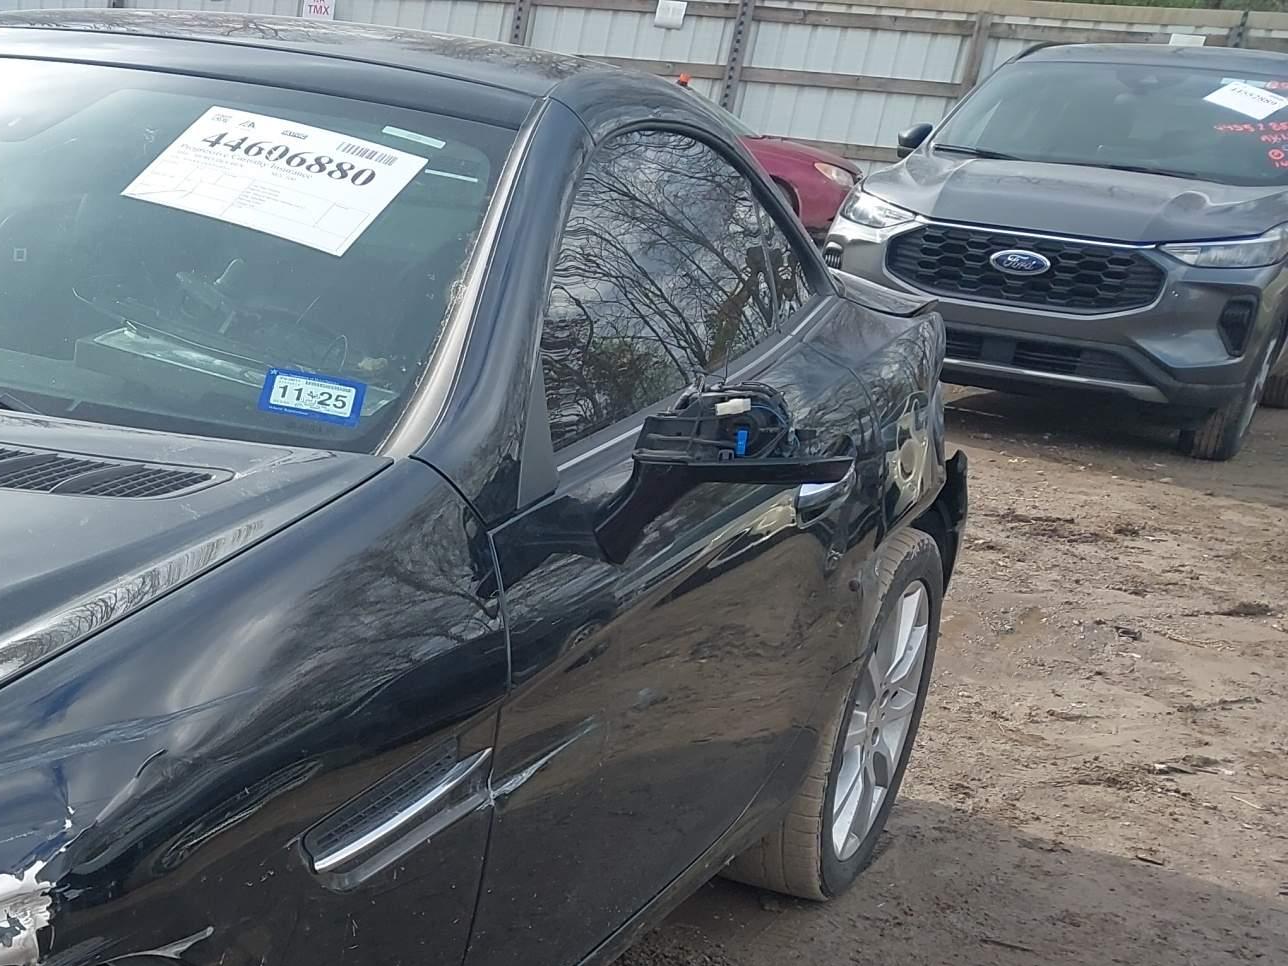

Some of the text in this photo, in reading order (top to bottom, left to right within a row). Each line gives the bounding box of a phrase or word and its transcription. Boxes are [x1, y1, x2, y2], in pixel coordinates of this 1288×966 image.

[308, 4, 330, 15] TMX
[201, 131, 376, 186] 44606880
[1003, 254, 1037, 270] Ford
[278, 384, 304, 401] 11
[317, 391, 348, 410] 25
